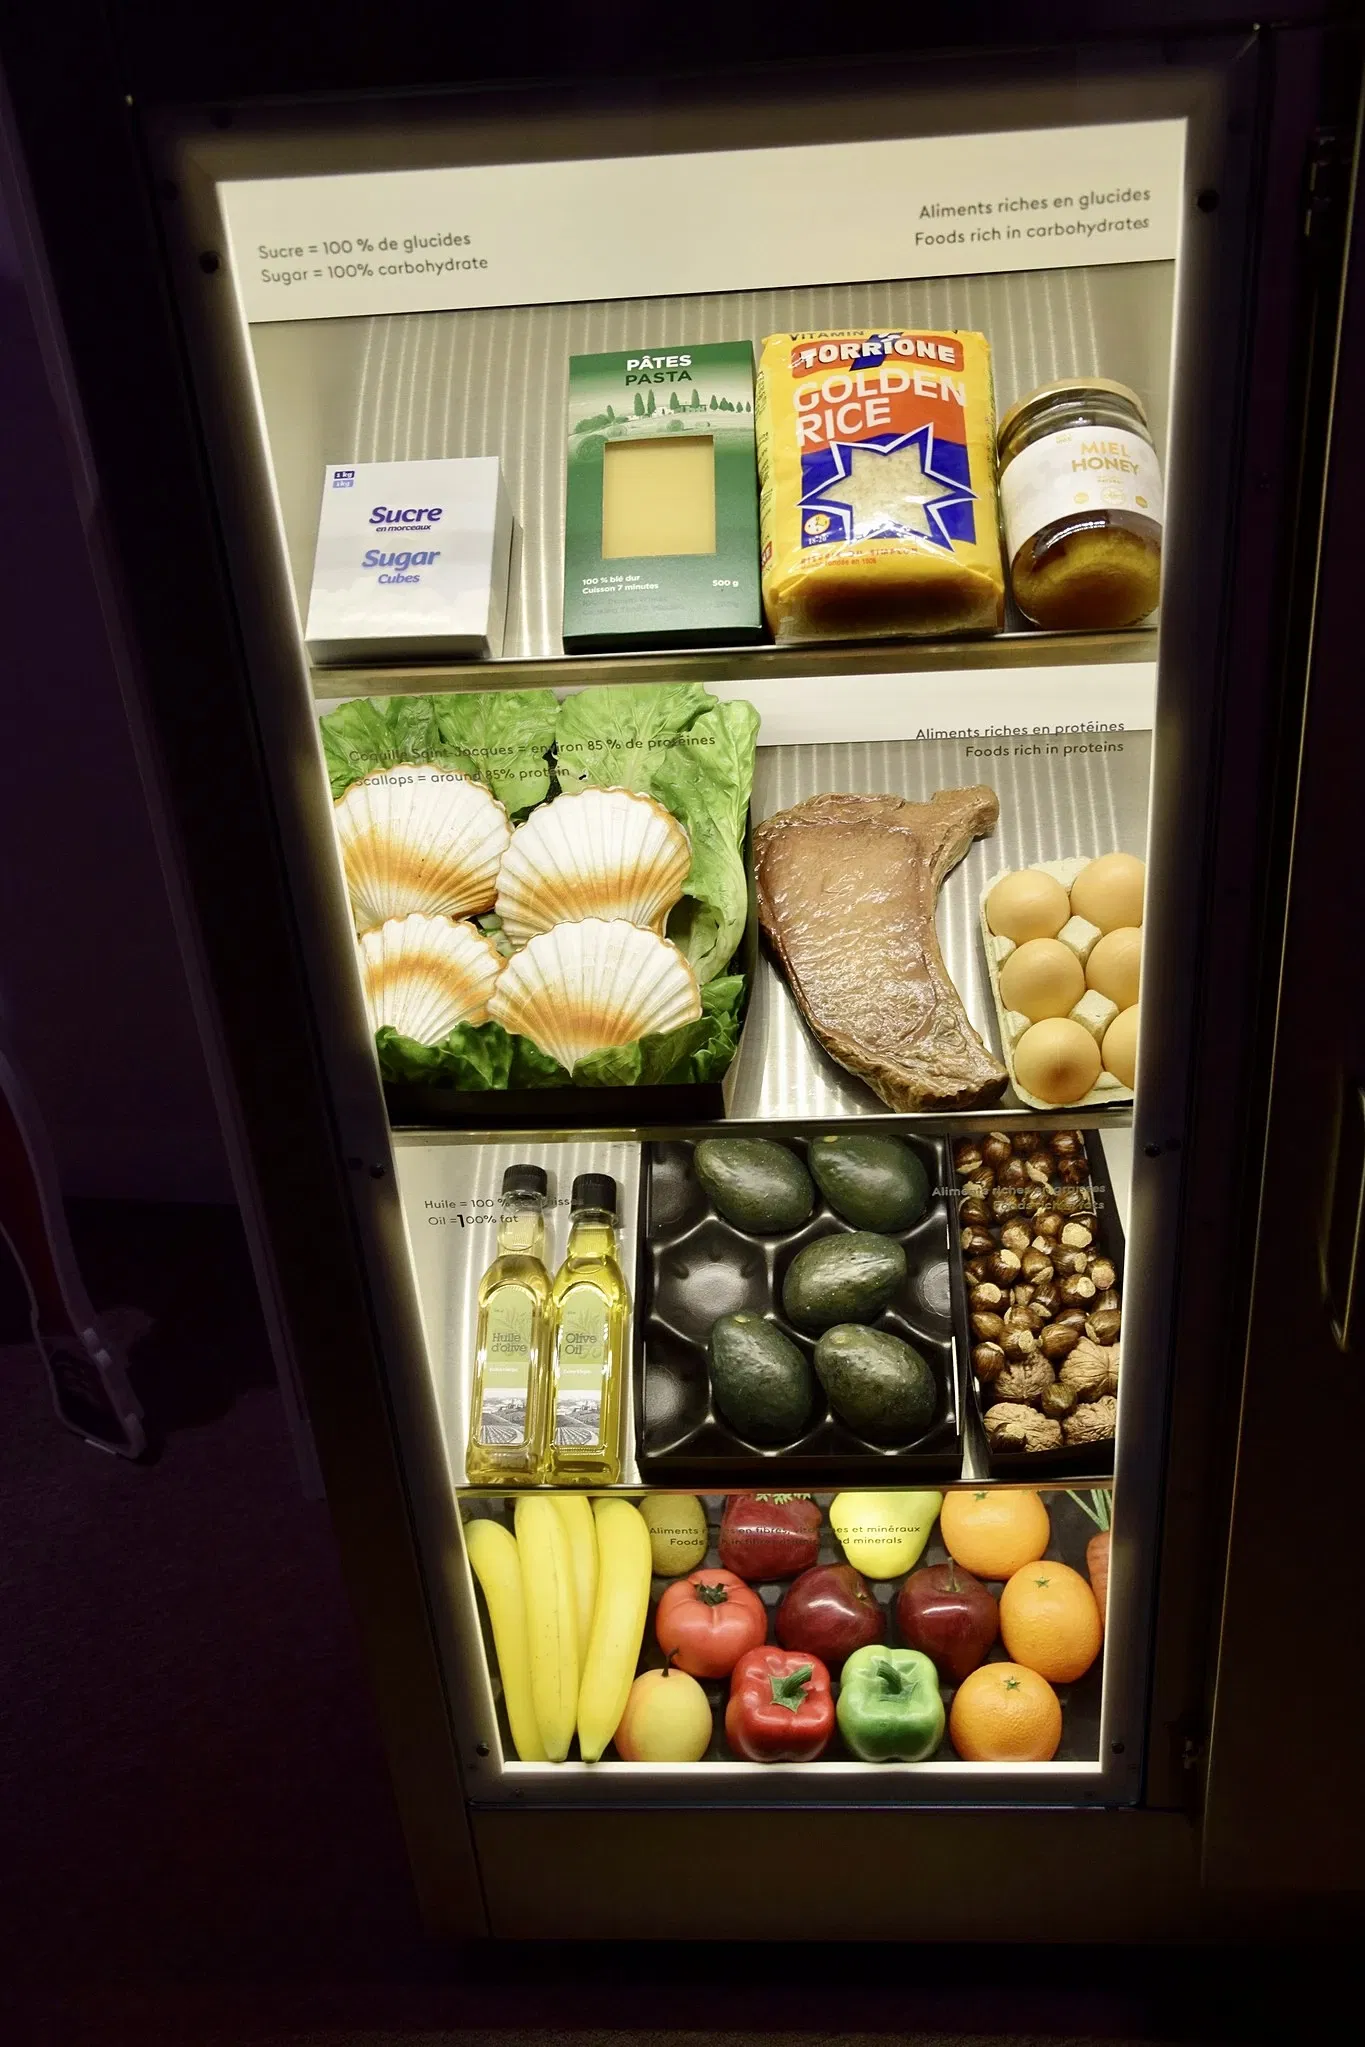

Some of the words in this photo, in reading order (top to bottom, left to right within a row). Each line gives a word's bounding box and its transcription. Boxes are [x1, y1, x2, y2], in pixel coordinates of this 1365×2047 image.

[919, 202, 993, 219] Aliments
[998, 197, 1048, 213] riches
[1053, 196, 1073, 208] en
[1079, 188, 1151, 209] glucides
[915, 230, 965, 246] Foods
[970, 227, 1001, 242] rich
[1006, 226, 1021, 239] in
[1026, 217, 1149, 238] carbohydrates
[258, 245, 304, 259] Sucre
[309, 245, 318, 253] =
[323, 240, 352, 255] 100
[357, 238, 374, 252] %
[378, 238, 398, 251] de
[403, 233, 471, 253] glucides
[261, 269, 308, 285] Sugar
[313, 269, 322, 277] =
[327, 264, 374, 279] 100%
[378, 257, 488, 276] carbohydrate
[789, 331, 864, 341] VITAMIN
[799, 337, 956, 369] TORRIONE
[626, 354, 692, 372] PÂTES
[625, 370, 692, 386] PASTA
[793, 368, 967, 412] GOLDEN
[796, 397, 891, 447] RICE
[1081, 441, 1130, 458] MIEL
[1071, 456, 1140, 476] HONEY
[369, 506, 443, 524] Sucre
[388, 524, 432, 532] morceaux
[362, 549, 441, 572] Sugar
[378, 573, 420, 585] Cubes
[582, 577, 599, 586] 100
[600, 576, 608, 584] %
[625, 574, 641, 582] dur
[712, 579, 731, 587] 500
[732, 580, 739, 588] g
[582, 586, 616, 595] Cuisson
[624, 583, 659, 592] minutes
[916, 726, 980, 741] Aliments
[985, 725, 1028, 738] riches
[1033, 726, 1050, 736] en
[1055, 720, 1125, 737] protéines
[350, 749, 408, 763] Coquille
[413, 745, 514, 762] Saint-Jacques
[587, 740, 603, 751] 85
[606, 739, 621, 750] %
[625, 738, 643, 750] de
[649, 735, 716, 752] protéines
[966, 745, 1010, 758] Foods
[1014, 743, 1041, 756] rich
[1046, 743, 1059, 755] in
[1064, 741, 1124, 757] proteins
[355, 774, 414, 788] Scallops
[431, 770, 482, 784] around
[485, 768, 516, 781] 85%
[424, 1199, 457, 1209] Huile
[471, 1199, 494, 1208] 100
[497, 1198, 510, 1207] %
[428, 1216, 446, 1226] Oil
[457, 1214, 497, 1228] 100%
[500, 1214, 519, 1224] fat
[492, 1332, 521, 1343] Huile
[566, 1332, 598, 1344] Olive
[491, 1343, 528, 1353] d'olive
[565, 1344, 583, 1355] Oil
[650, 1527, 699, 1535] Aliments
[866, 1524, 921, 1533] minéraux
[670, 1538, 705, 1546] Foods
[853, 1536, 903, 1545] minerals
